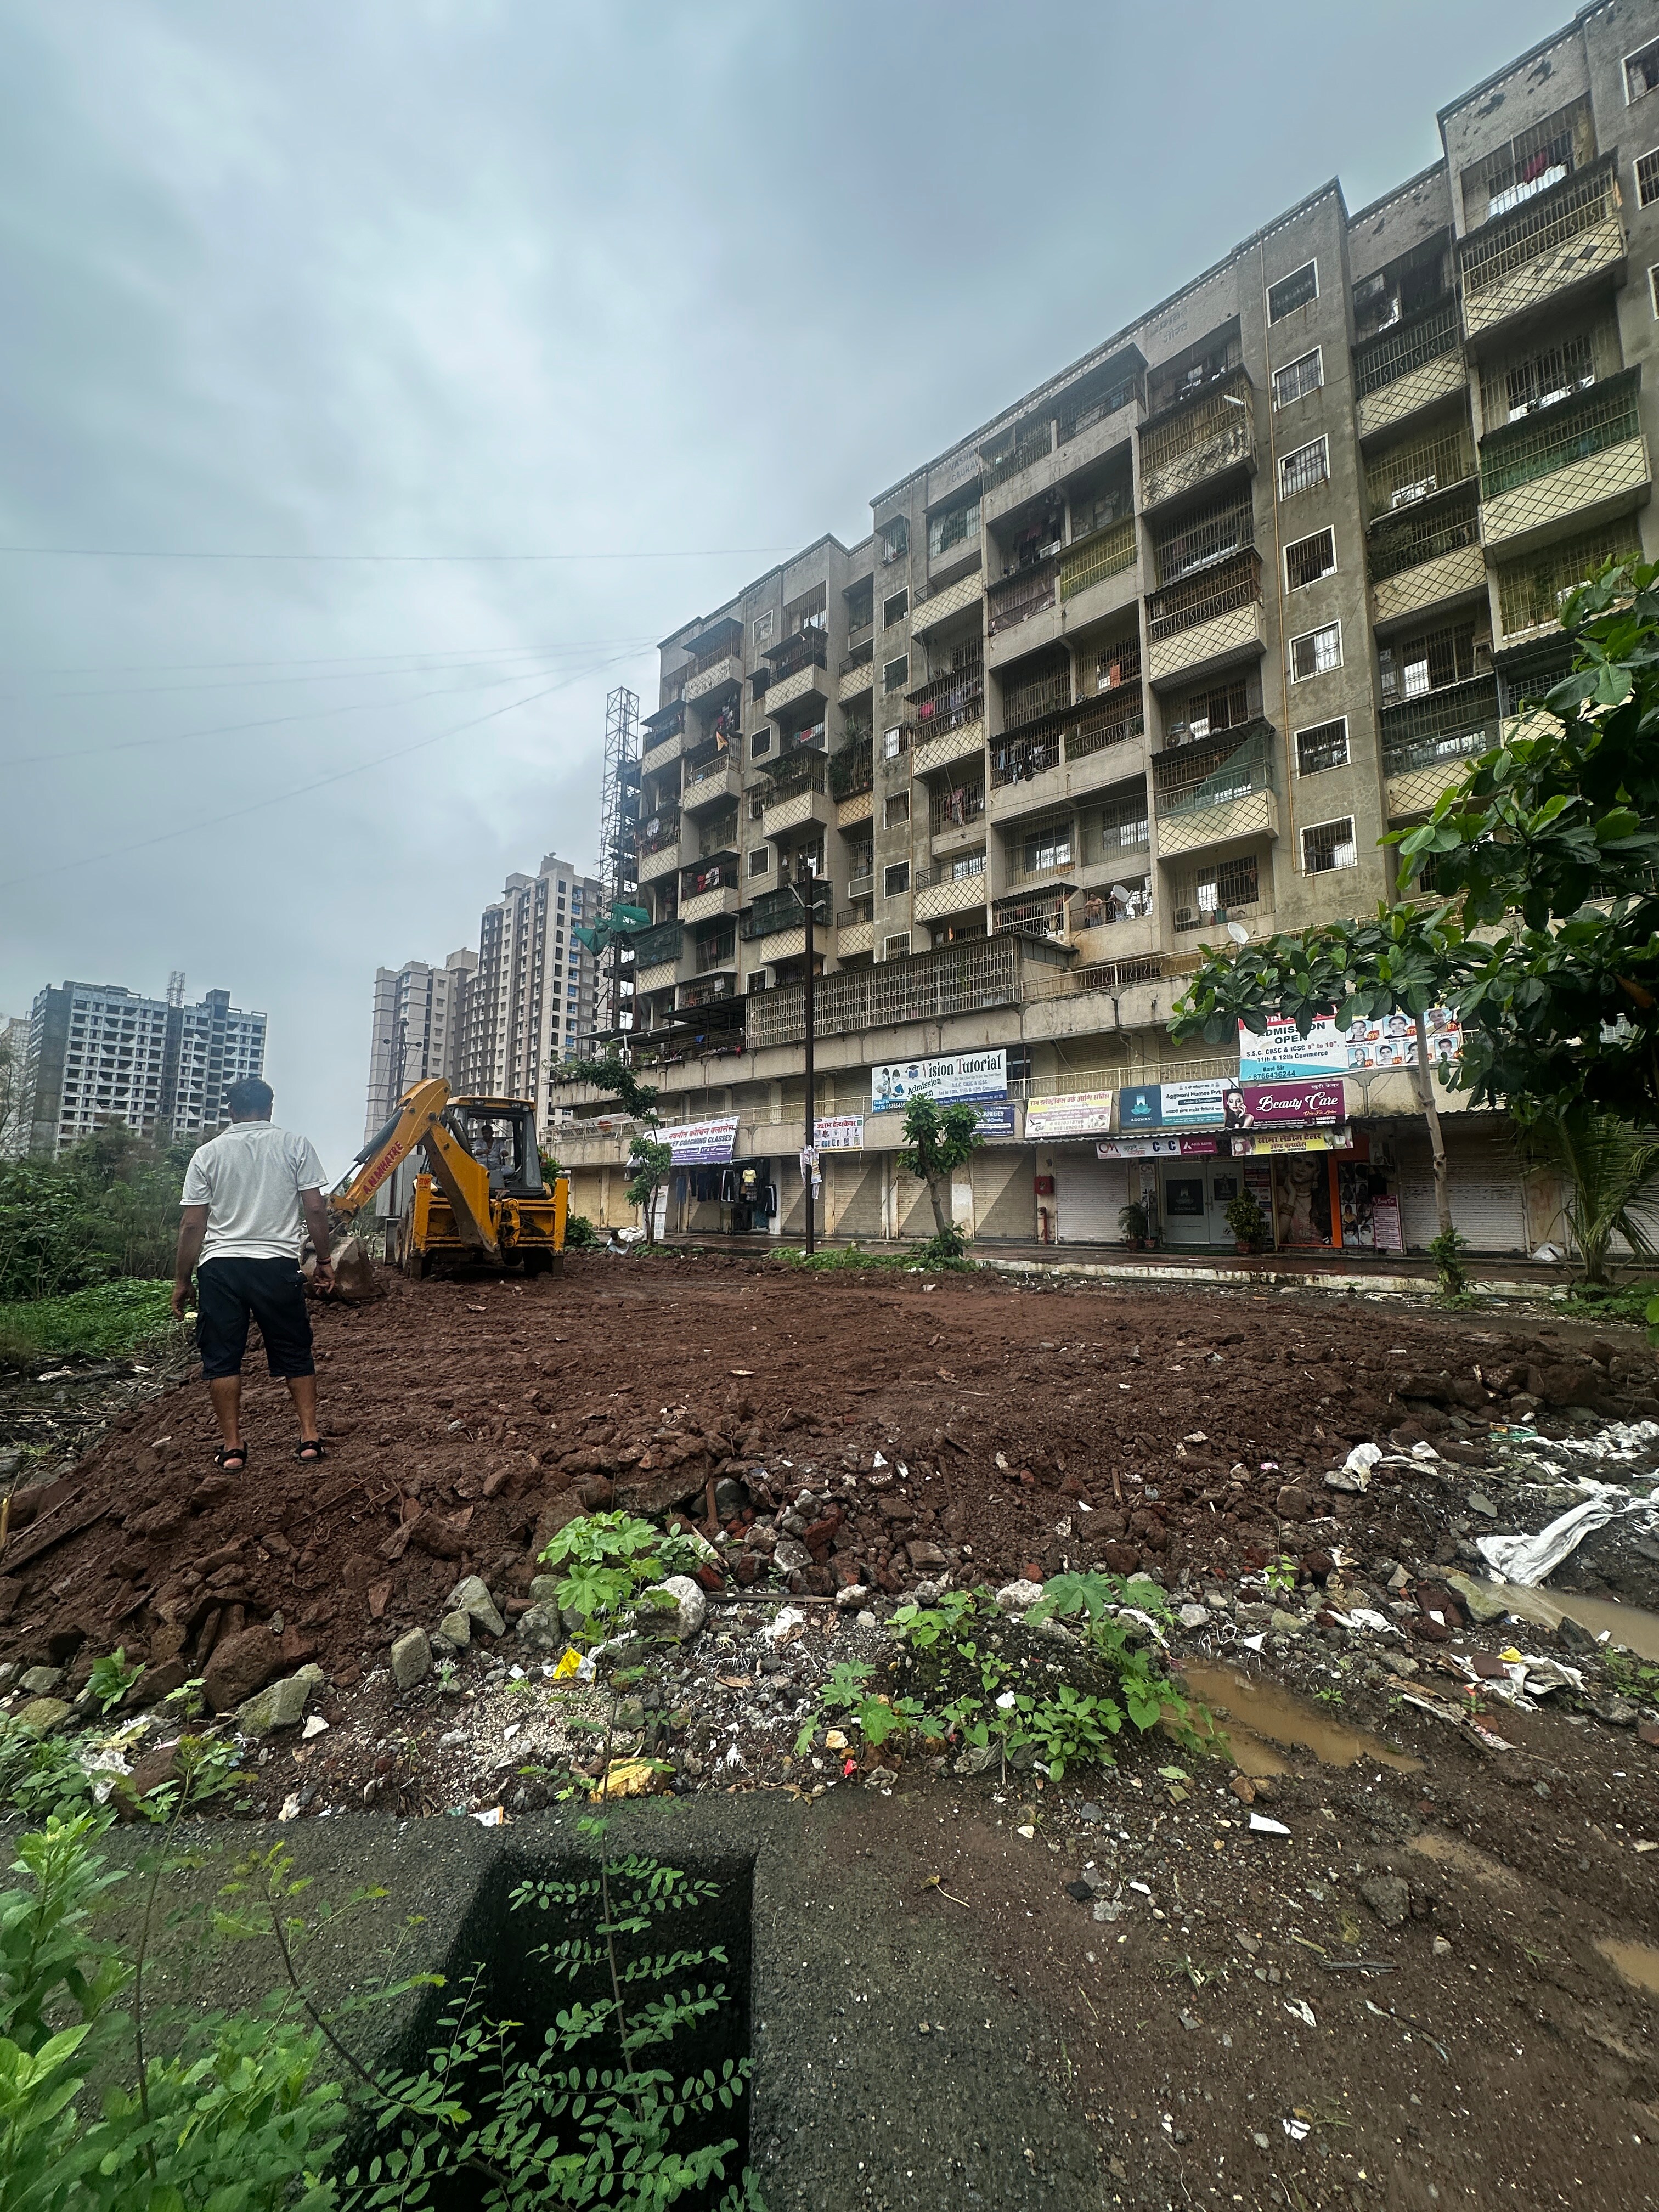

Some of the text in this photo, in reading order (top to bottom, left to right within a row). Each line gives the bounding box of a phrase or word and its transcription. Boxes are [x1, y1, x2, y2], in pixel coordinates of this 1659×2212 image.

[949, 449, 977, 471] YASHW
[952, 460, 979, 482] GAURAV
[1274, 1035, 1308, 1044] OPEN
[1295, 1050, 1328, 1059] Commerce
[922, 1061, 954, 1078] Vision
[956, 1053, 1002, 1074] Tutorial
[1253, 1070, 1296, 1080] 8766436244
[907, 1077, 941, 1095] Admission
[1165, 1091, 1189, 1099] Aggwani
[1256, 1091, 1339, 1112] Beauty Care
[679, 1137, 707, 1147] COACHING
[708, 1134, 732, 1143] CLASSES
